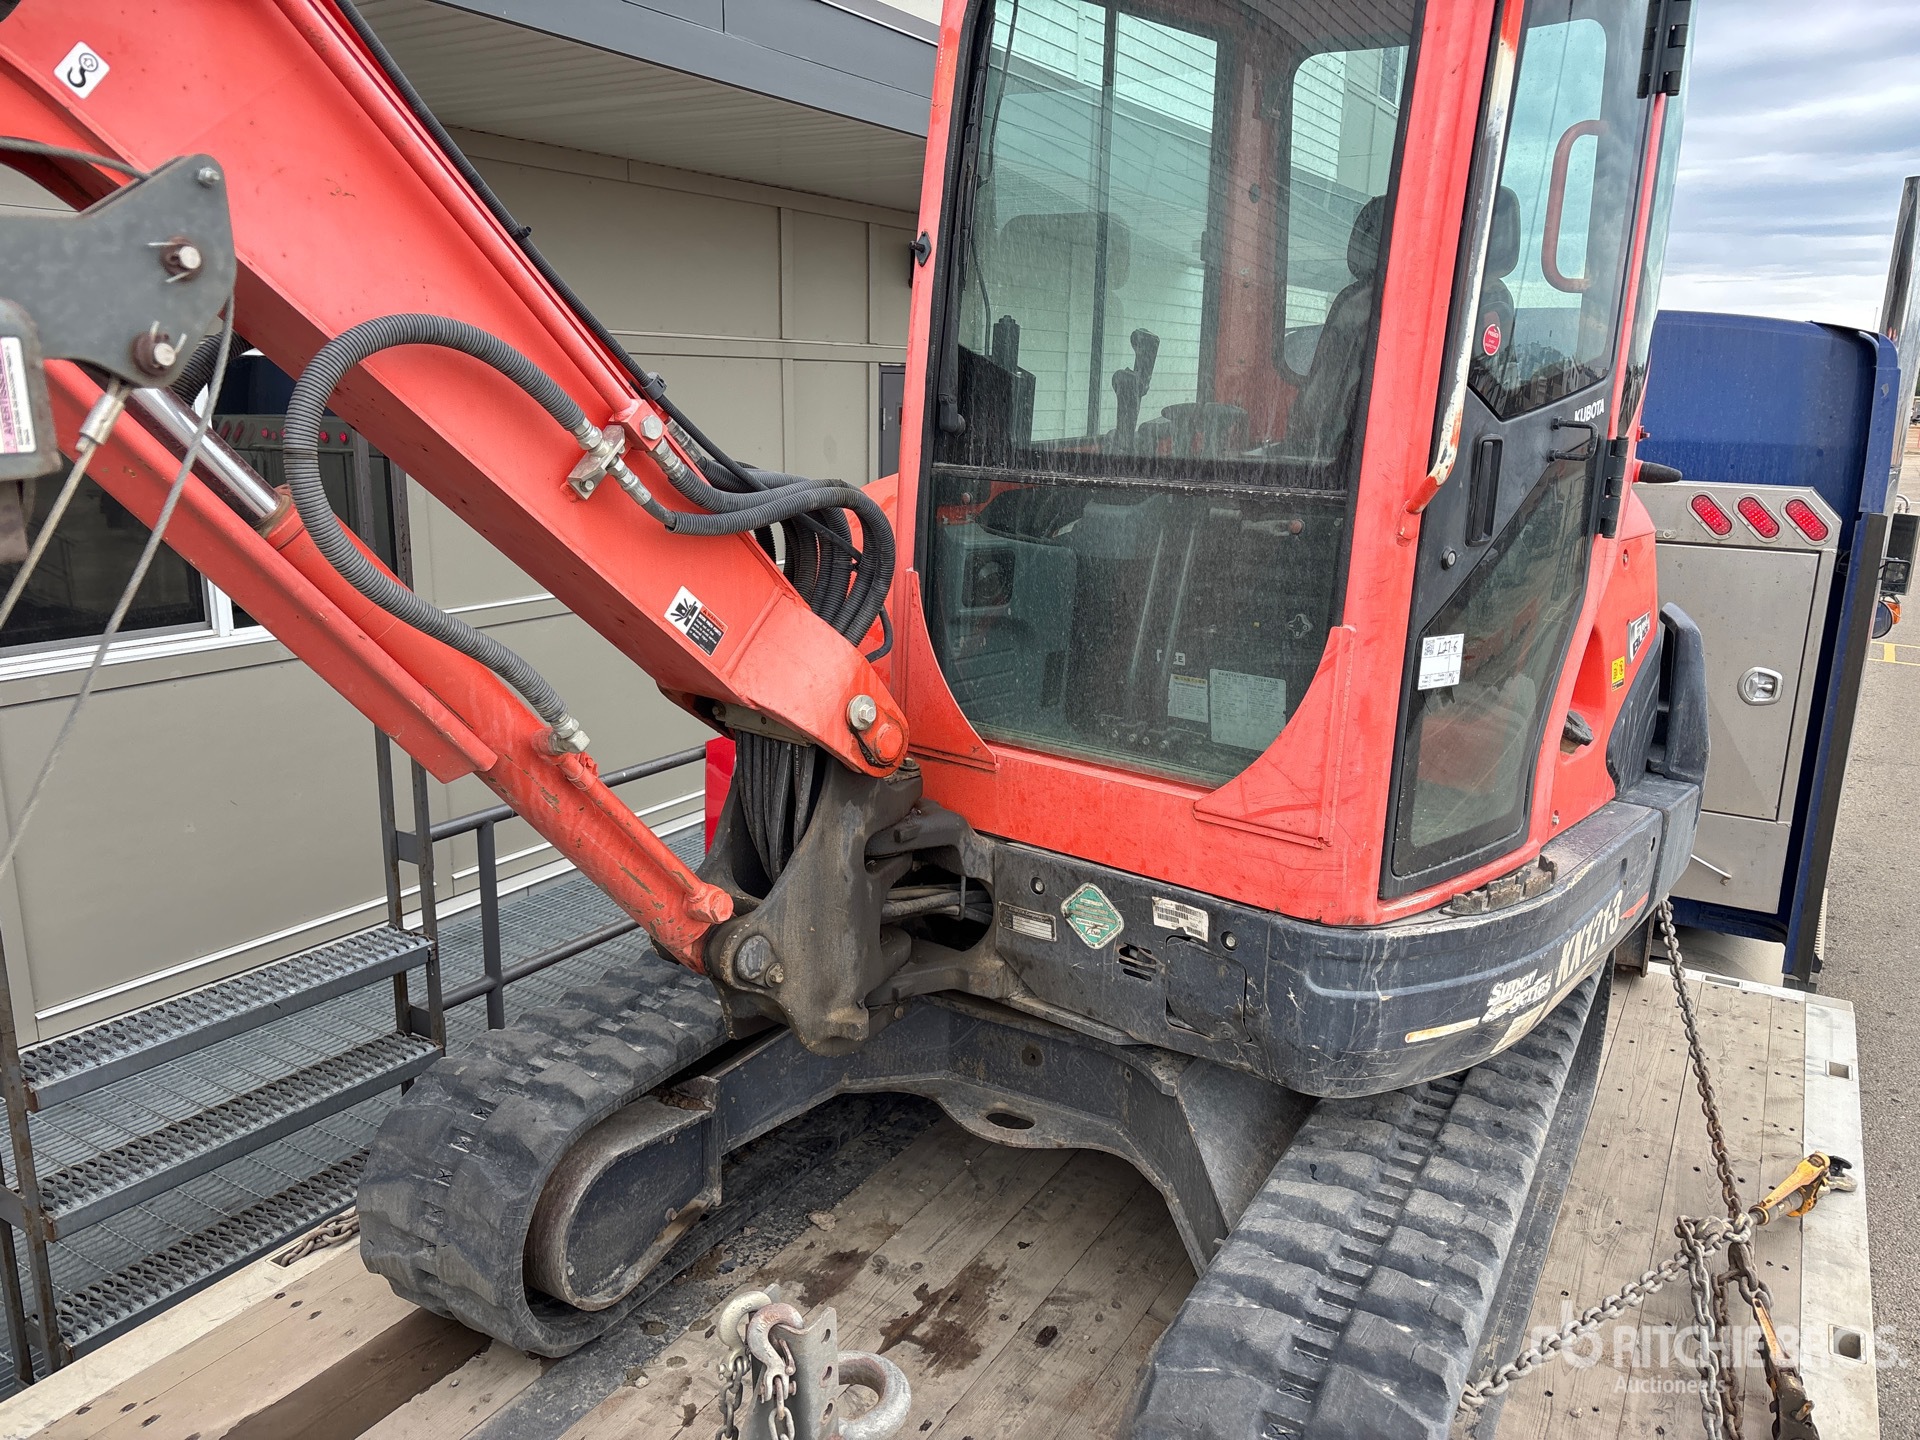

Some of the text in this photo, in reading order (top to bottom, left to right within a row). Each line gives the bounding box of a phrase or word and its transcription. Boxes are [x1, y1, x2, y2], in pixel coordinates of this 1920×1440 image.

[1574, 398, 1605, 422] KUBOTA
[1555, 889, 1623, 988] KX121-3
[1488, 969, 1538, 1005] Super
